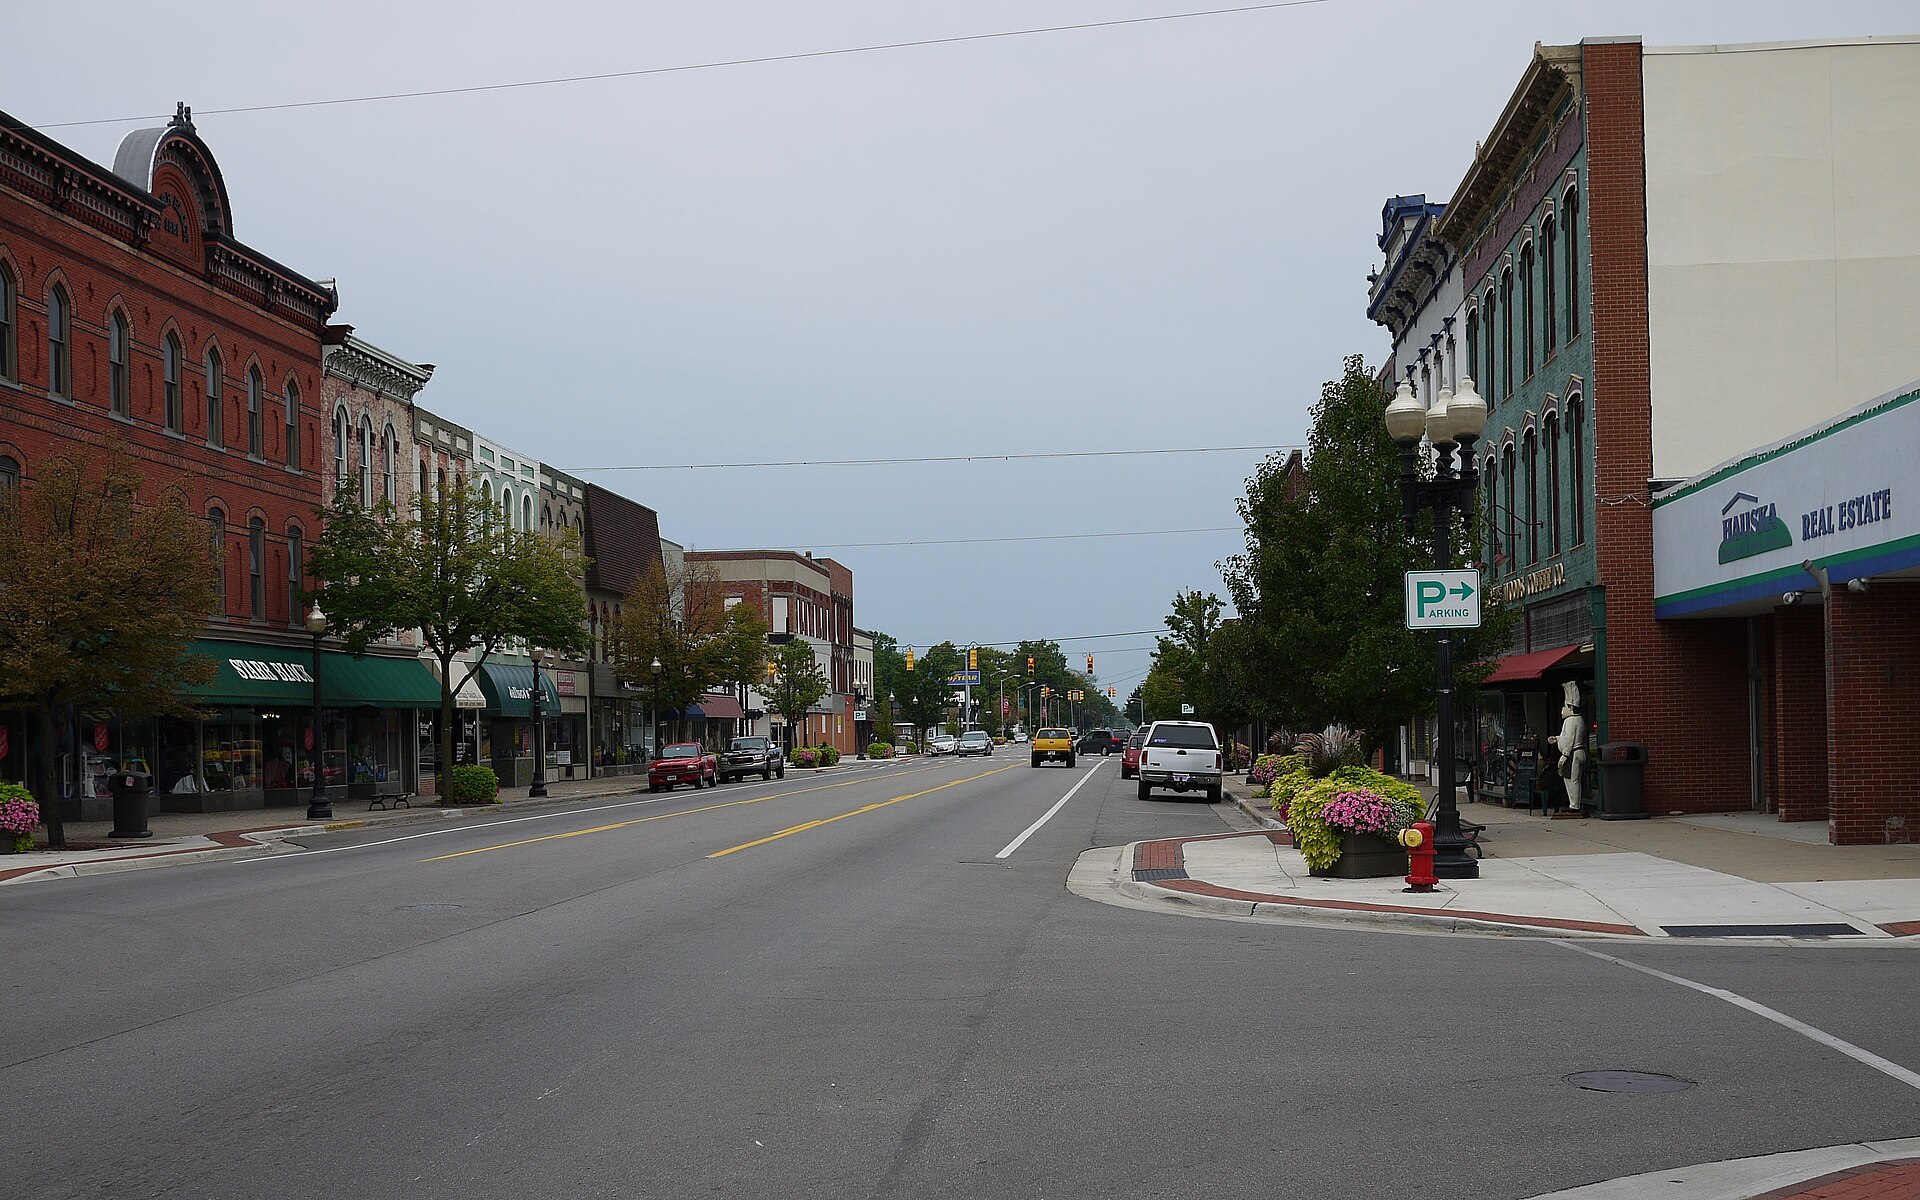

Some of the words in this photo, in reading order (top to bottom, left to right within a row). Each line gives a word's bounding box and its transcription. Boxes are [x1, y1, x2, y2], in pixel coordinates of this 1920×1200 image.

[1722, 503, 1777, 545] HAUSKA
[1802, 506, 1835, 541] REAL
[1838, 488, 1891, 531] ESTATE
[1417, 581, 1470, 618] PARKING
[228, 659, 279, 681] STARR
[269, 662, 315, 682] BLOCK
